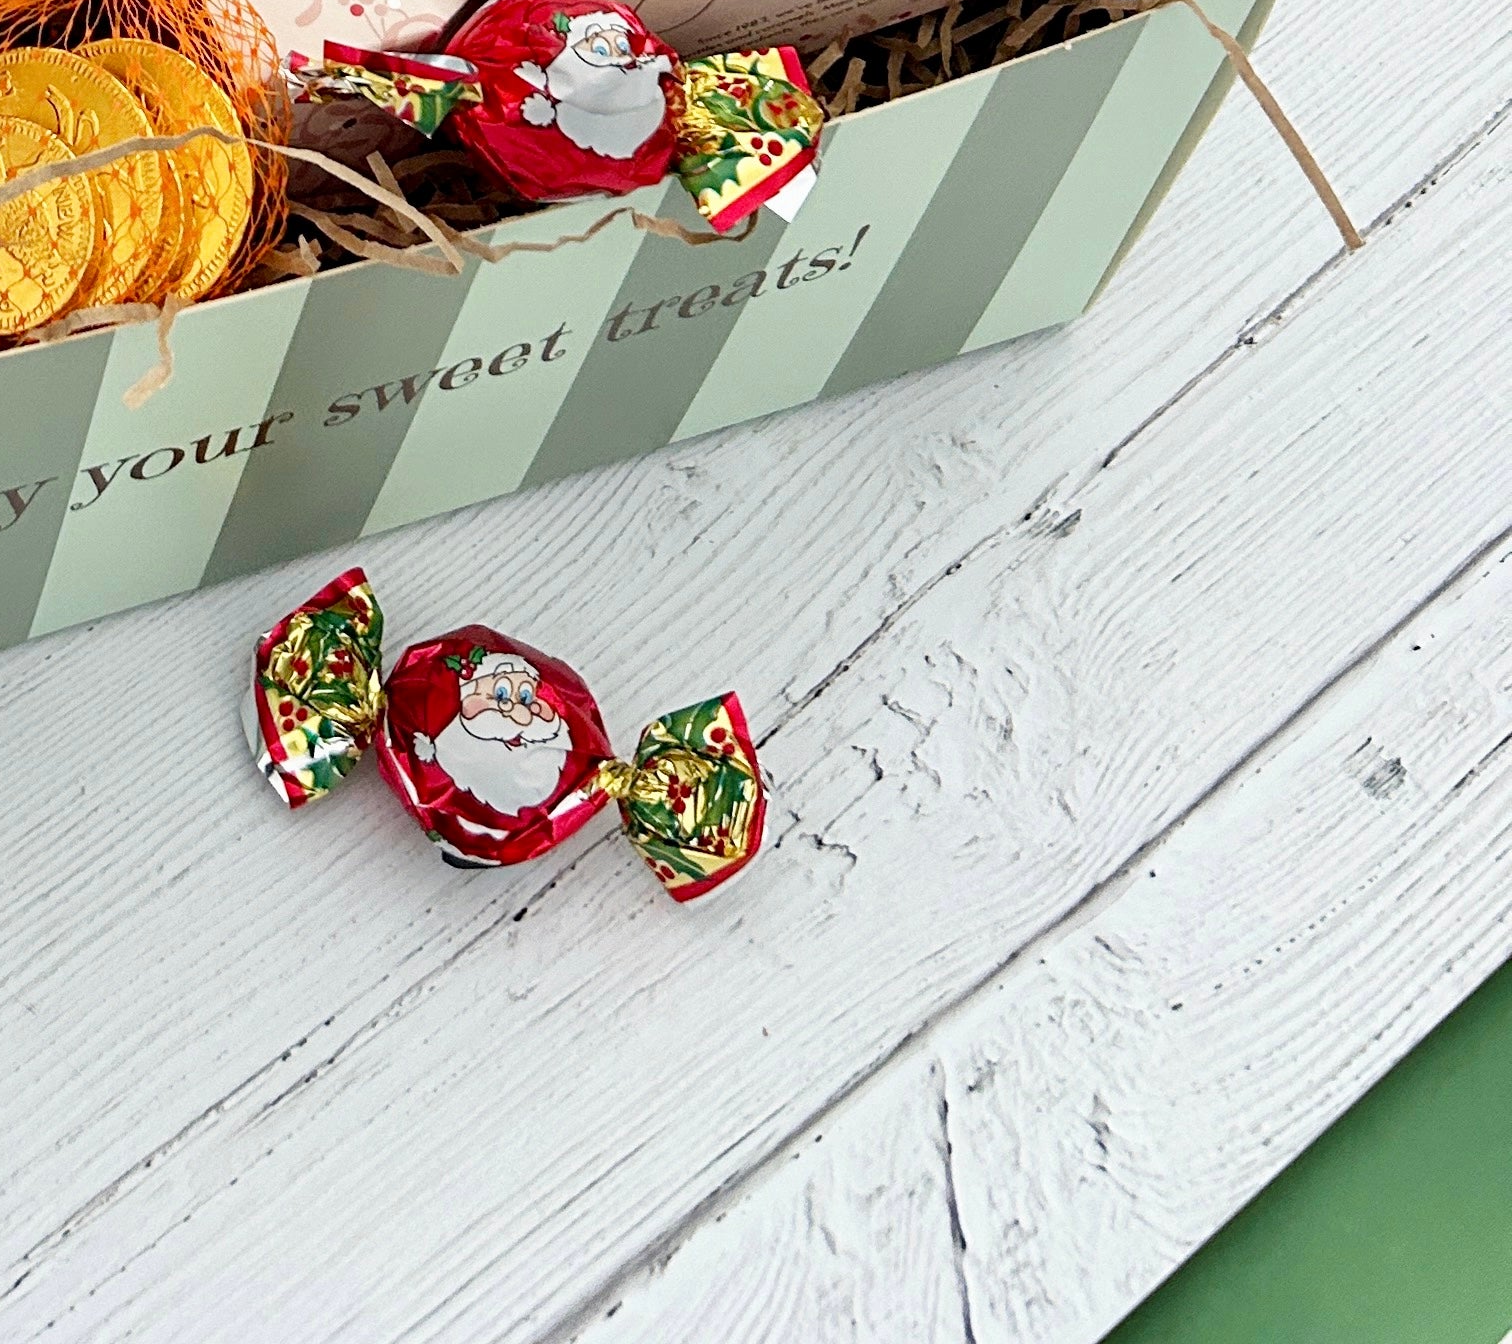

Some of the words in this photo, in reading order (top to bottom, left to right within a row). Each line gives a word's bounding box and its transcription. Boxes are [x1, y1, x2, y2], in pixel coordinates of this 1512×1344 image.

[69, 410, 296, 512] your
[323, 319, 570, 428] sweet
[599, 225, 872, 345] treats!
